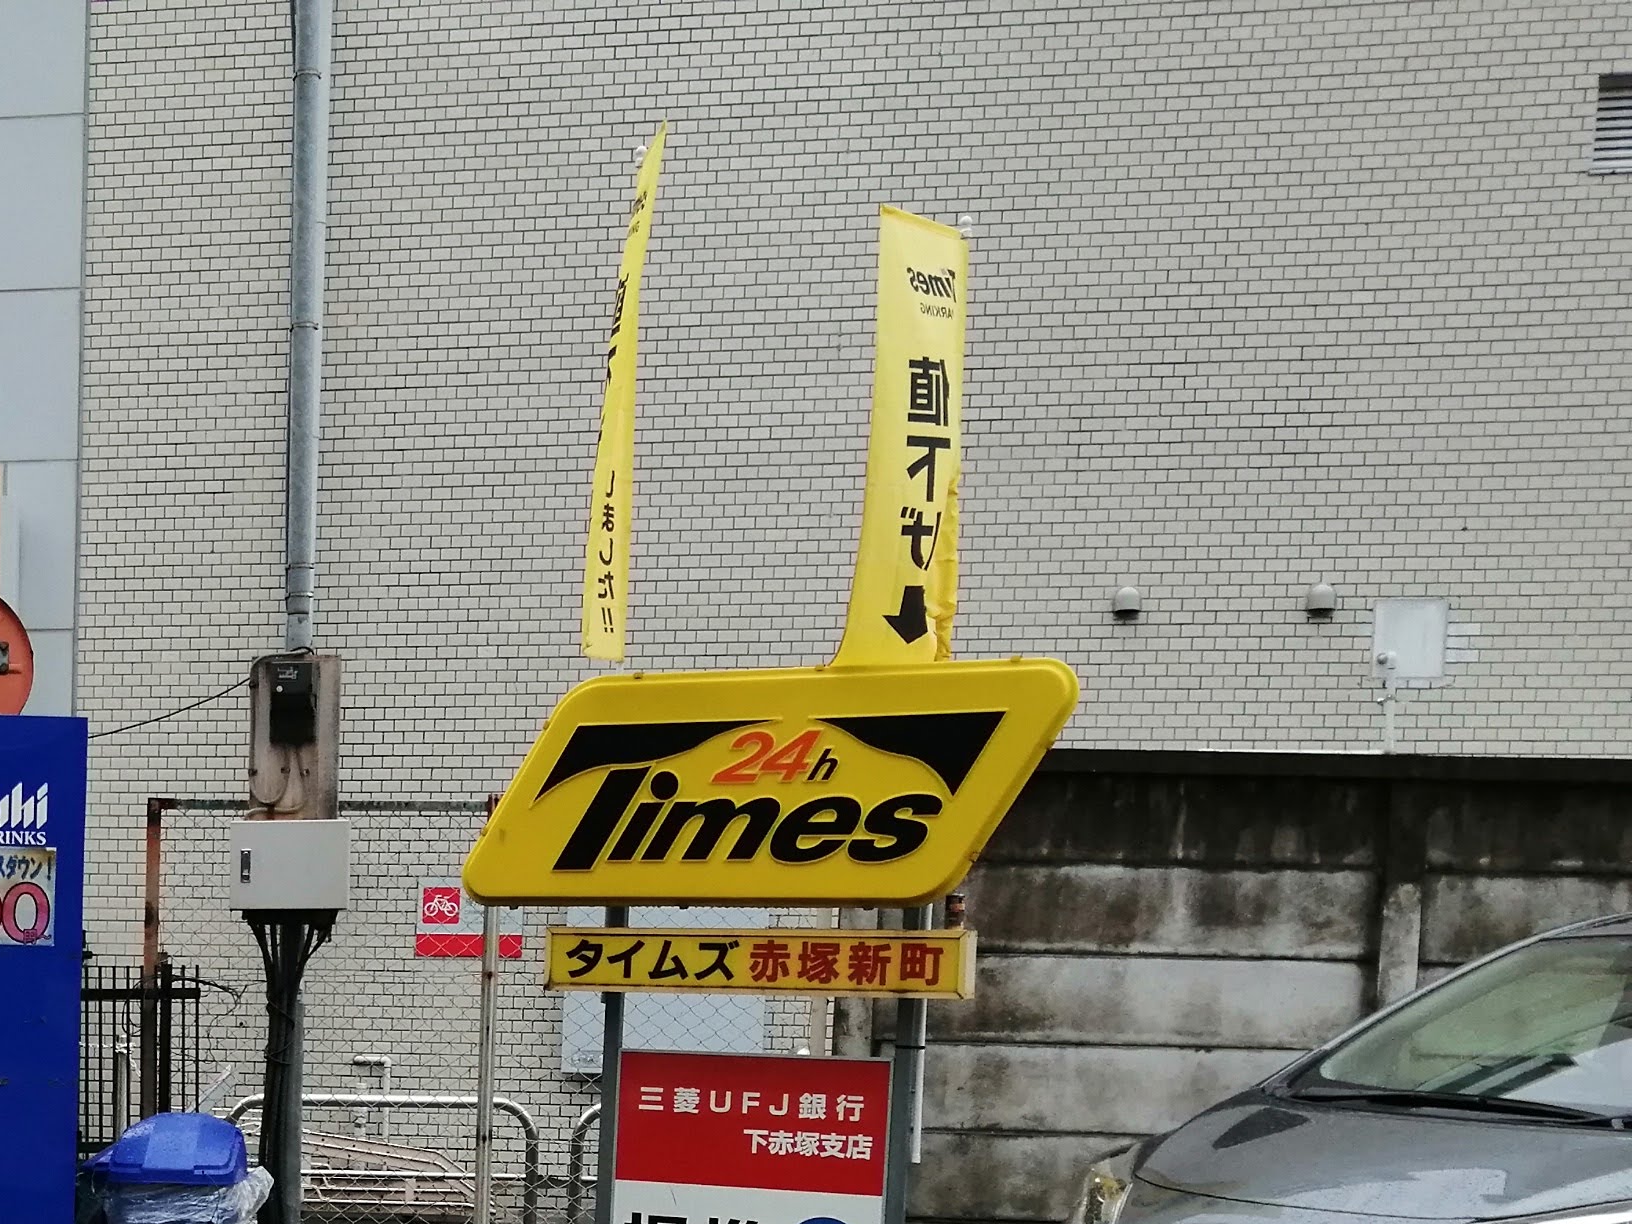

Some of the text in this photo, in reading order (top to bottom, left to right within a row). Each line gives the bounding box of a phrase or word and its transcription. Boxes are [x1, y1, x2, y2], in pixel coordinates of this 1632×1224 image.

[552, 764, 943, 873] Times
[638, 1086, 865, 1122] 三菱UFJ銀行
[743, 1128, 874, 1160] 下赤塚支店
